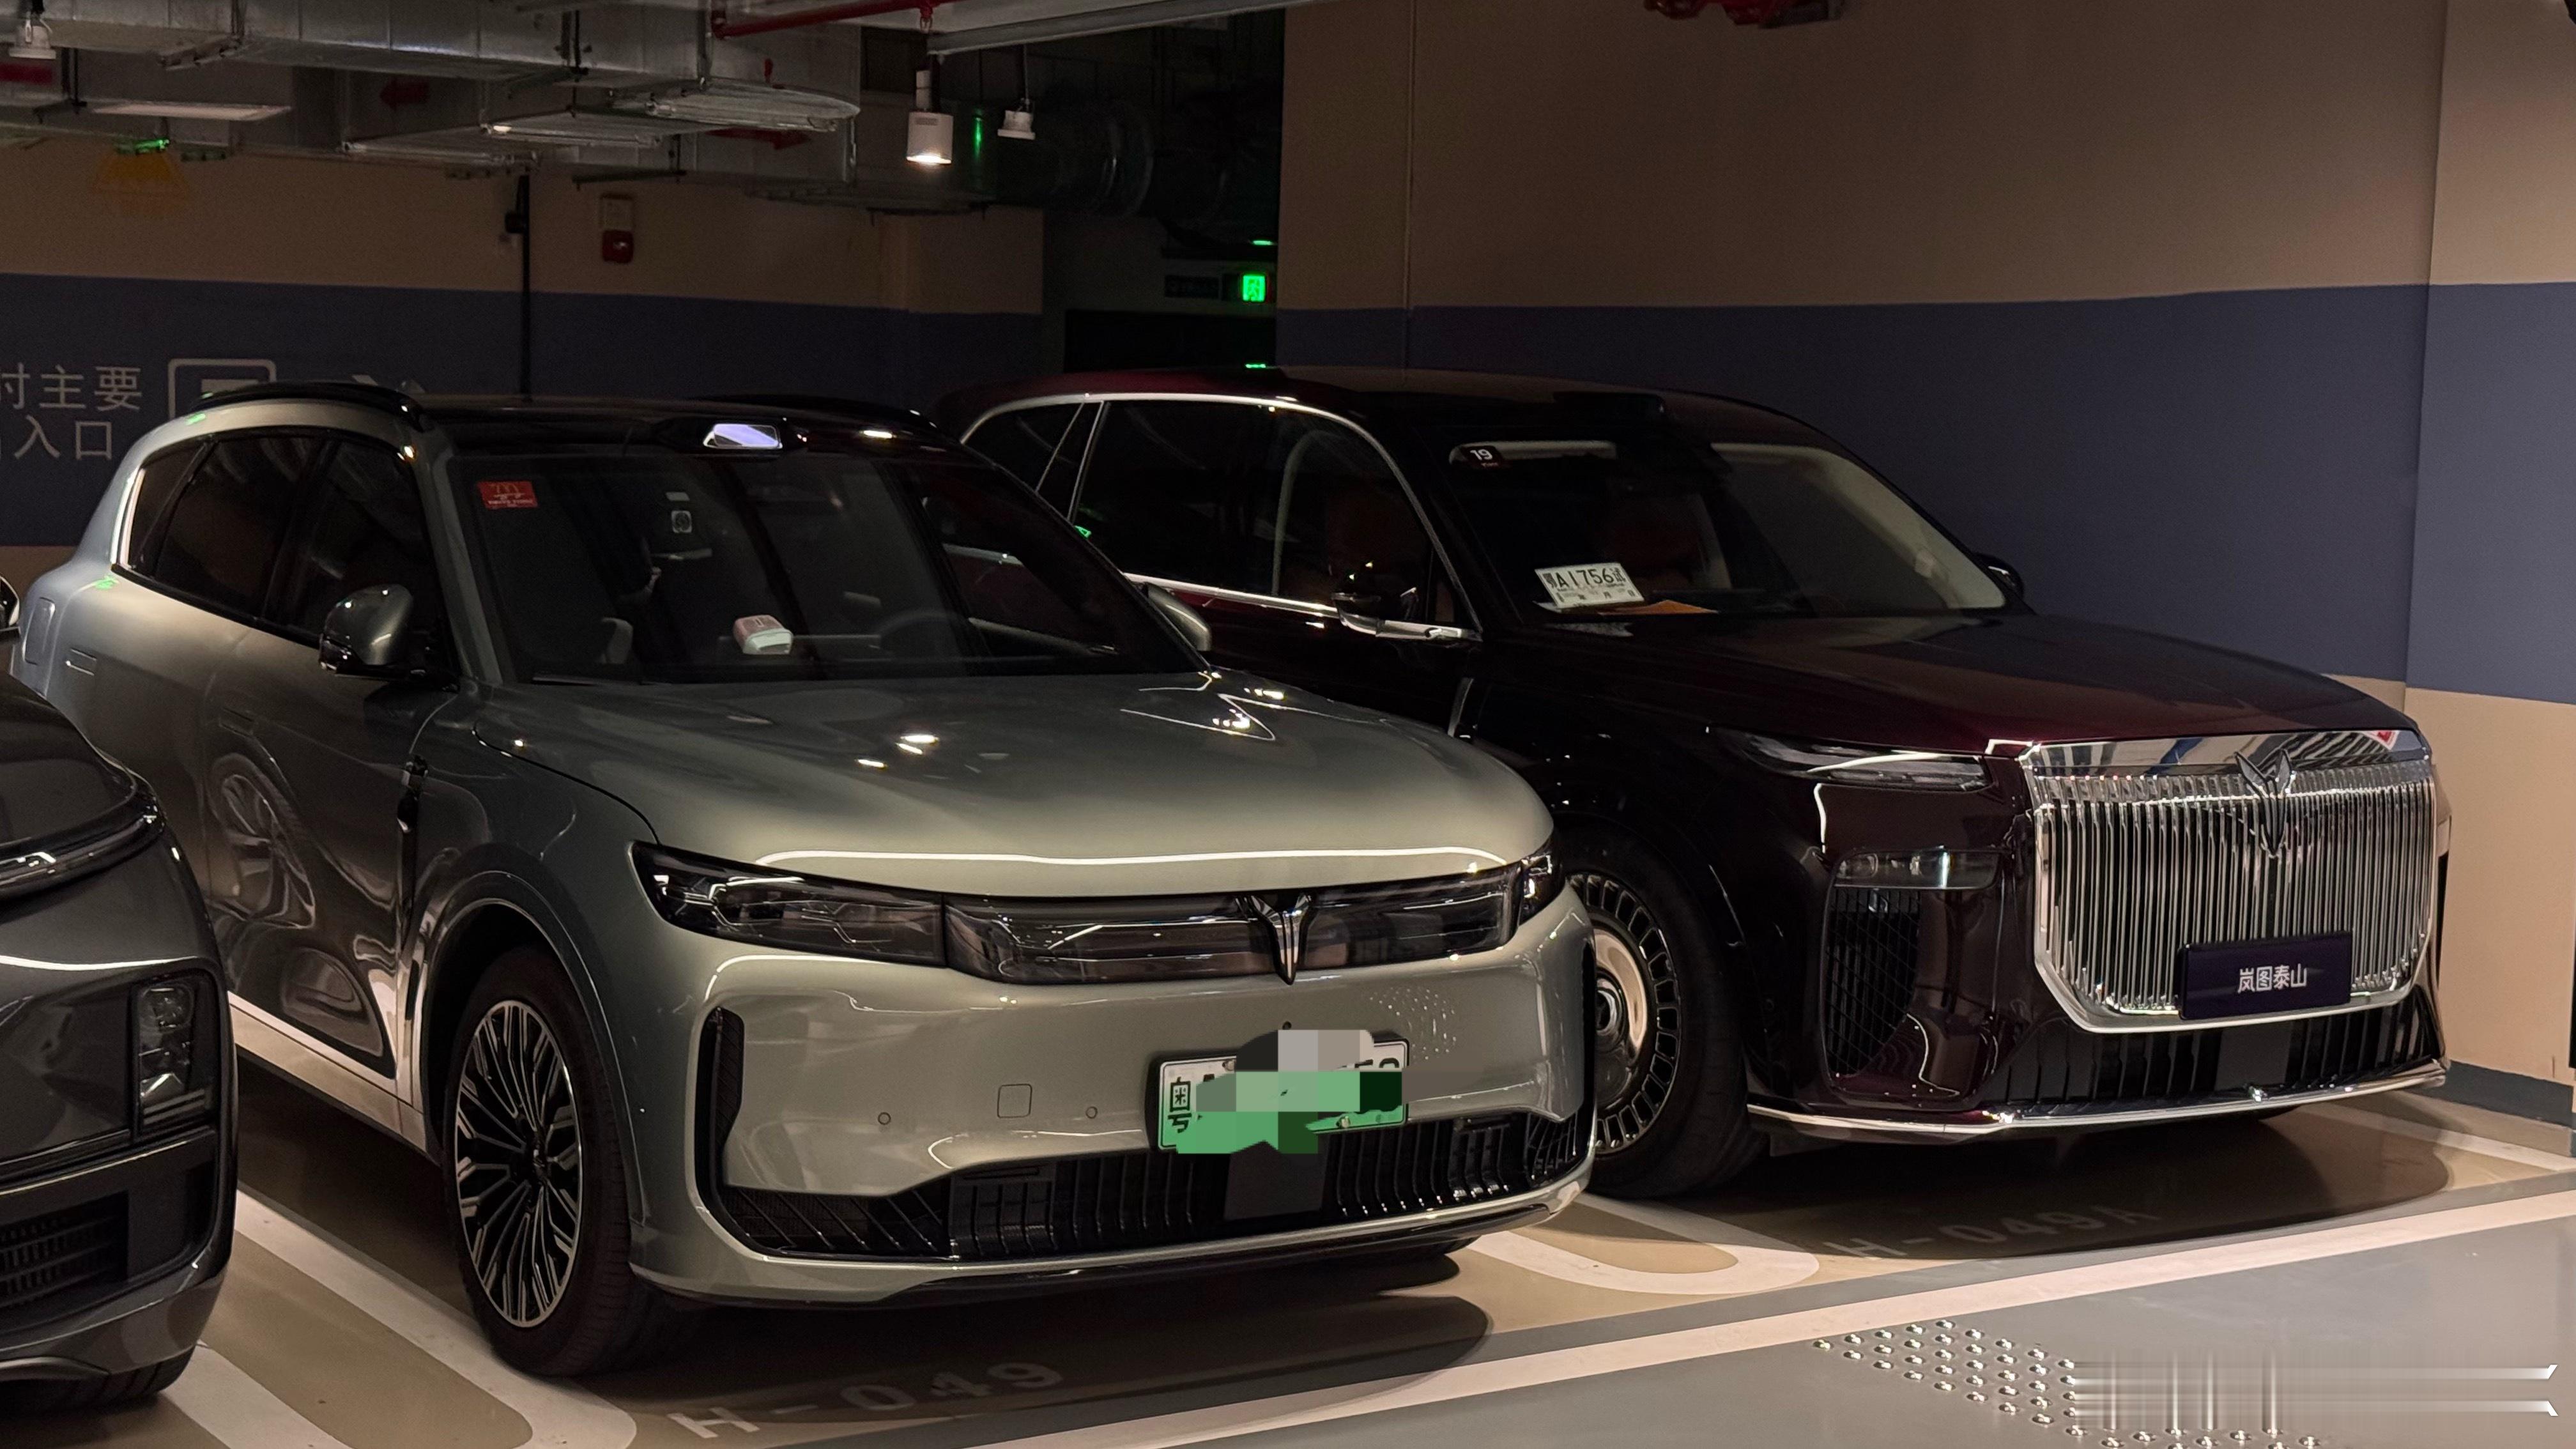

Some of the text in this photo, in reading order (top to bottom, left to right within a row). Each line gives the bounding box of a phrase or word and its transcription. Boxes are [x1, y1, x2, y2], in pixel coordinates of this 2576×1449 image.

[1469, 448, 1492, 460] 19
[2237, 963, 2307, 993] 岚图泰山
[668, 1362, 1063, 1438] H-049
